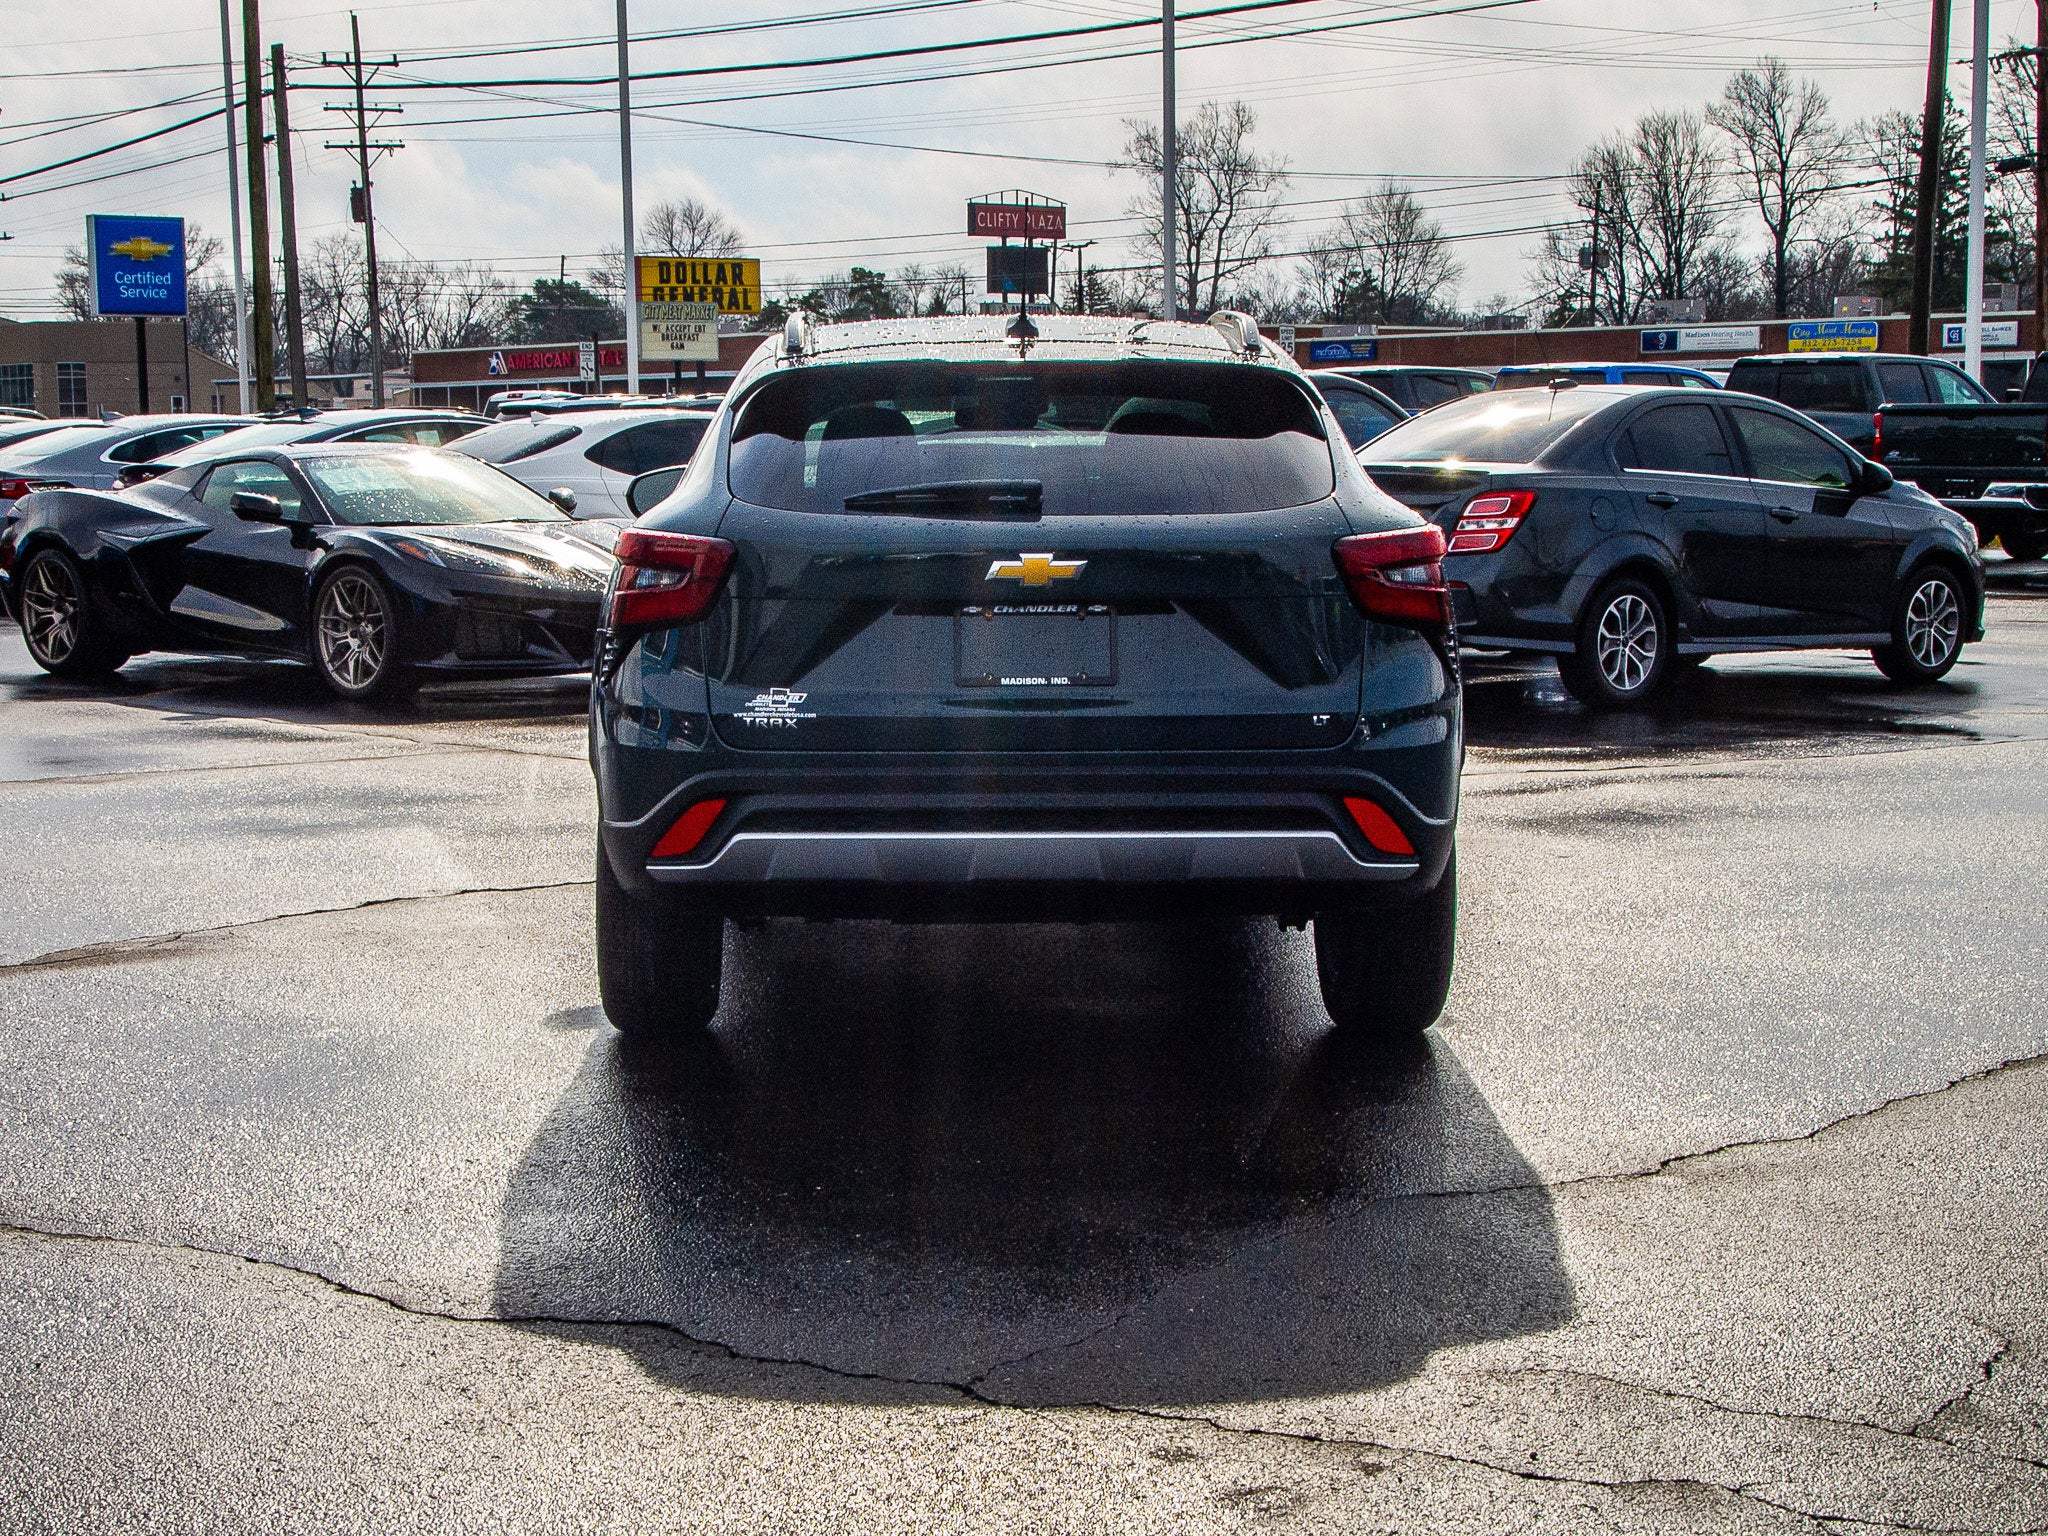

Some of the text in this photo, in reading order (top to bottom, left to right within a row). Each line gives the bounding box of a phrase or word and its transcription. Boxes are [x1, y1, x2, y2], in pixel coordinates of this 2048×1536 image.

[977, 212, 1018, 228] CLIFTY
[114, 271, 171, 284] Certified
[658, 261, 744, 285] DOLLAR
[120, 285, 167, 298] Service
[653, 286, 752, 310] GENERAL
[644, 304, 715, 320] CITY MEAT MARKET
[665, 324, 691, 333] ACCEPT
[694, 324, 706, 333] EBT
[661, 333, 699, 341] BREAKFAST
[670, 342, 685, 350] 6AM
[507, 351, 572, 370] AMERICAN
[993, 605, 1078, 613] CHANDLER
[1050, 677, 1071, 685] IND.
[743, 717, 797, 729] TRAX
[1313, 715, 1330, 726] LT
